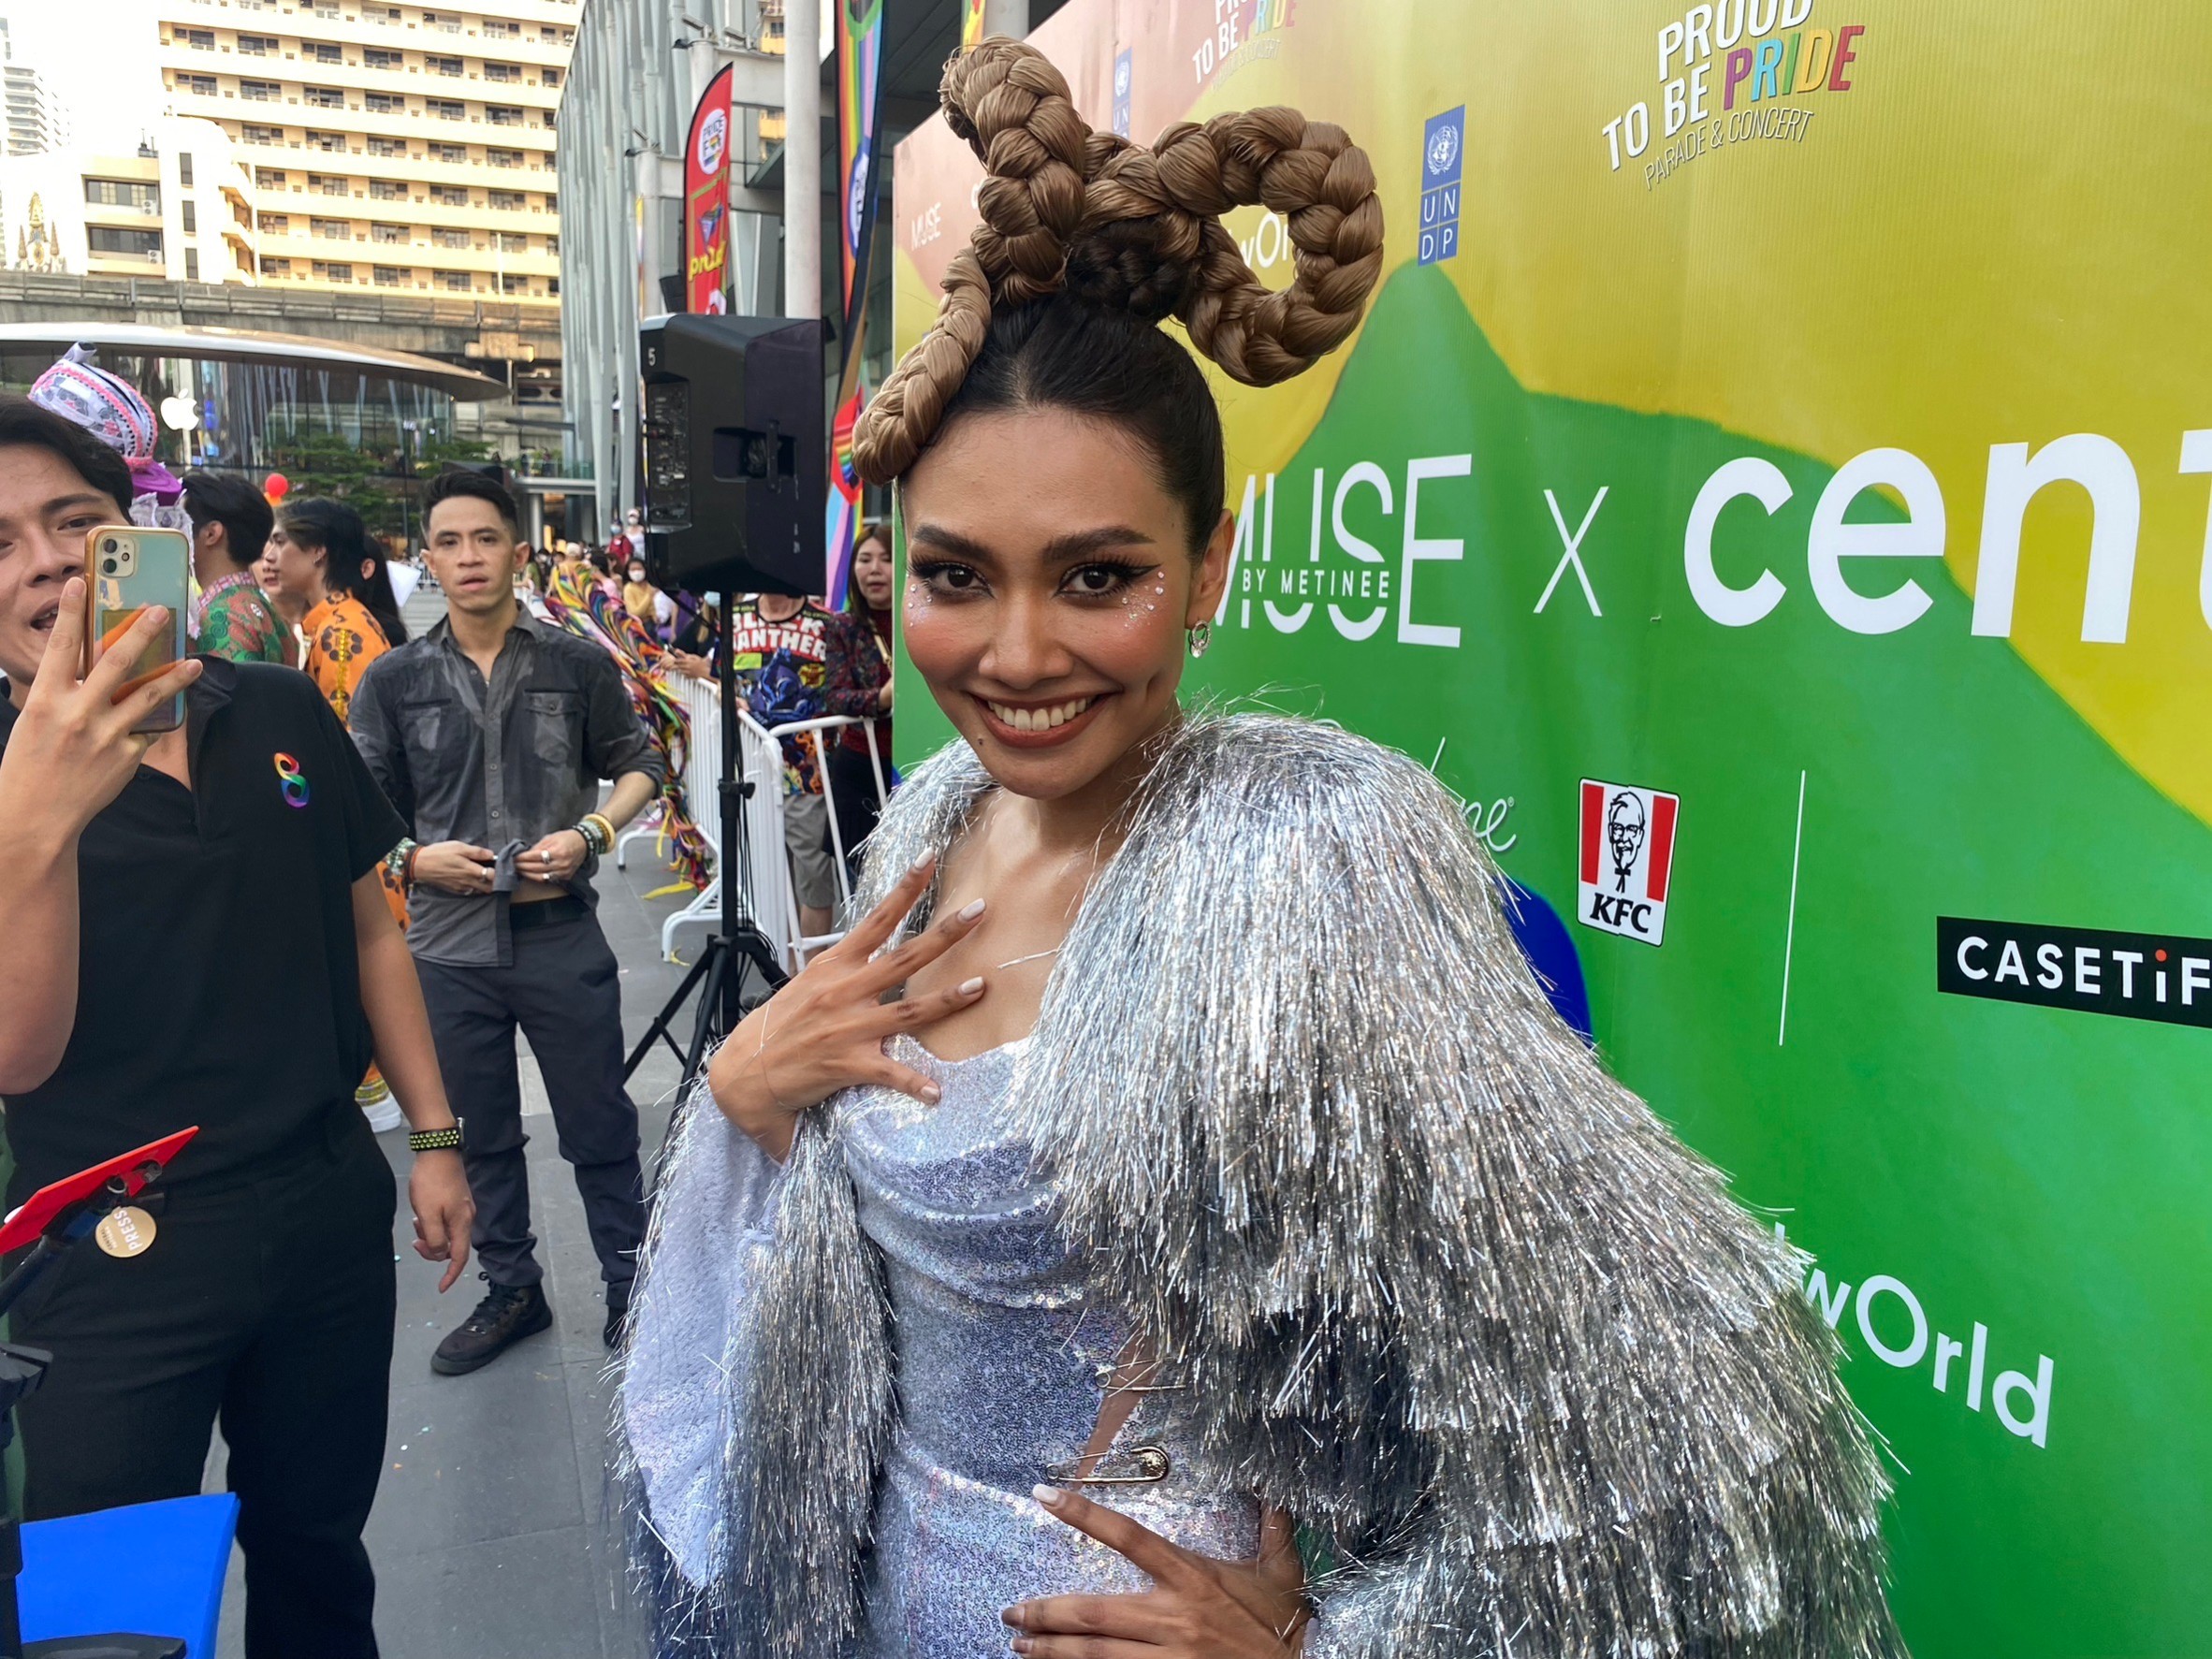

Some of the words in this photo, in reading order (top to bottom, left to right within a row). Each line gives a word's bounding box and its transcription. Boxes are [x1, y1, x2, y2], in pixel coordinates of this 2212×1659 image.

[1192, 37, 1214, 84] TO
[1218, 11, 1240, 60] BE
[1657, 0, 1812, 82] PROUD
[1601, 101, 1650, 171] TO
[1664, 62, 1711, 138] BE
[1723, 24, 1865, 111] PRIDE
[1643, 124, 1707, 191] PARADE
[1710, 118, 1724, 149] &
[1728, 107, 1815, 143] CONCERT
[1215, 454, 1472, 648] MUSE
[1242, 568, 1266, 592] BY
[1280, 569, 1390, 599] METINEE
[733, 628, 827, 662] ANTHER
[1589, 892, 1652, 934] KFC
[113, 1209, 144, 1251] PRESS
[1775, 1221, 2054, 1448] wOrld
